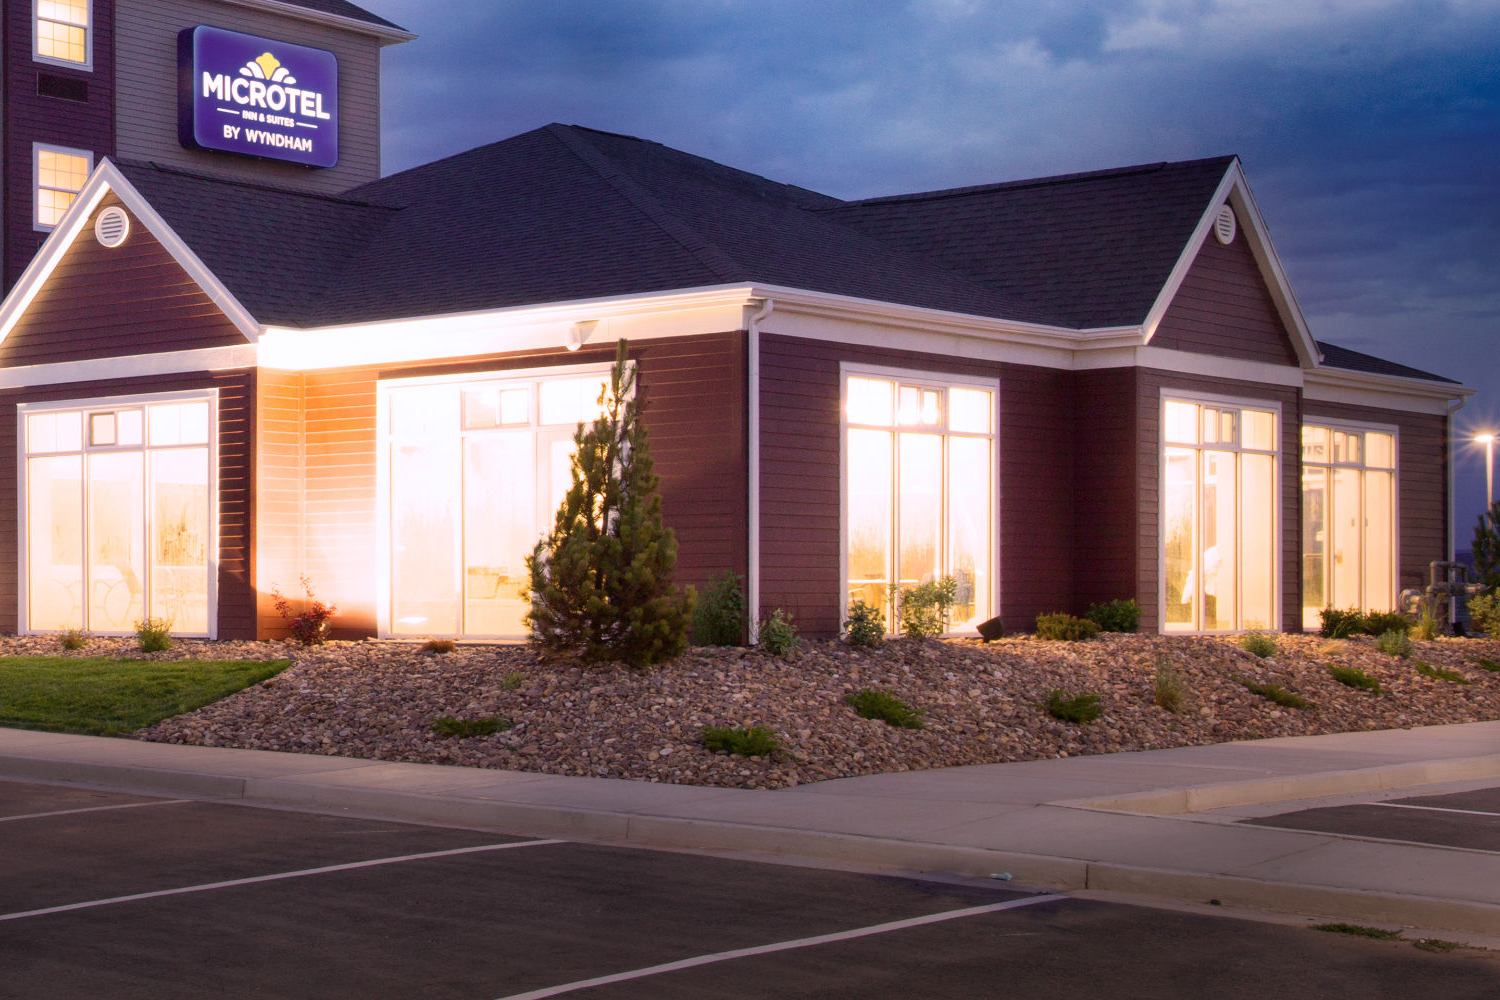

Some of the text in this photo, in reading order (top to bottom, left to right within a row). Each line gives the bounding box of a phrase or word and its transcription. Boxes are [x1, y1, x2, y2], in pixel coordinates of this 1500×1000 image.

[202, 71, 330, 120] MICROTEL
[242, 110, 295, 127] INN & SUITES
[223, 125, 312, 152] BY WYNDHAM
